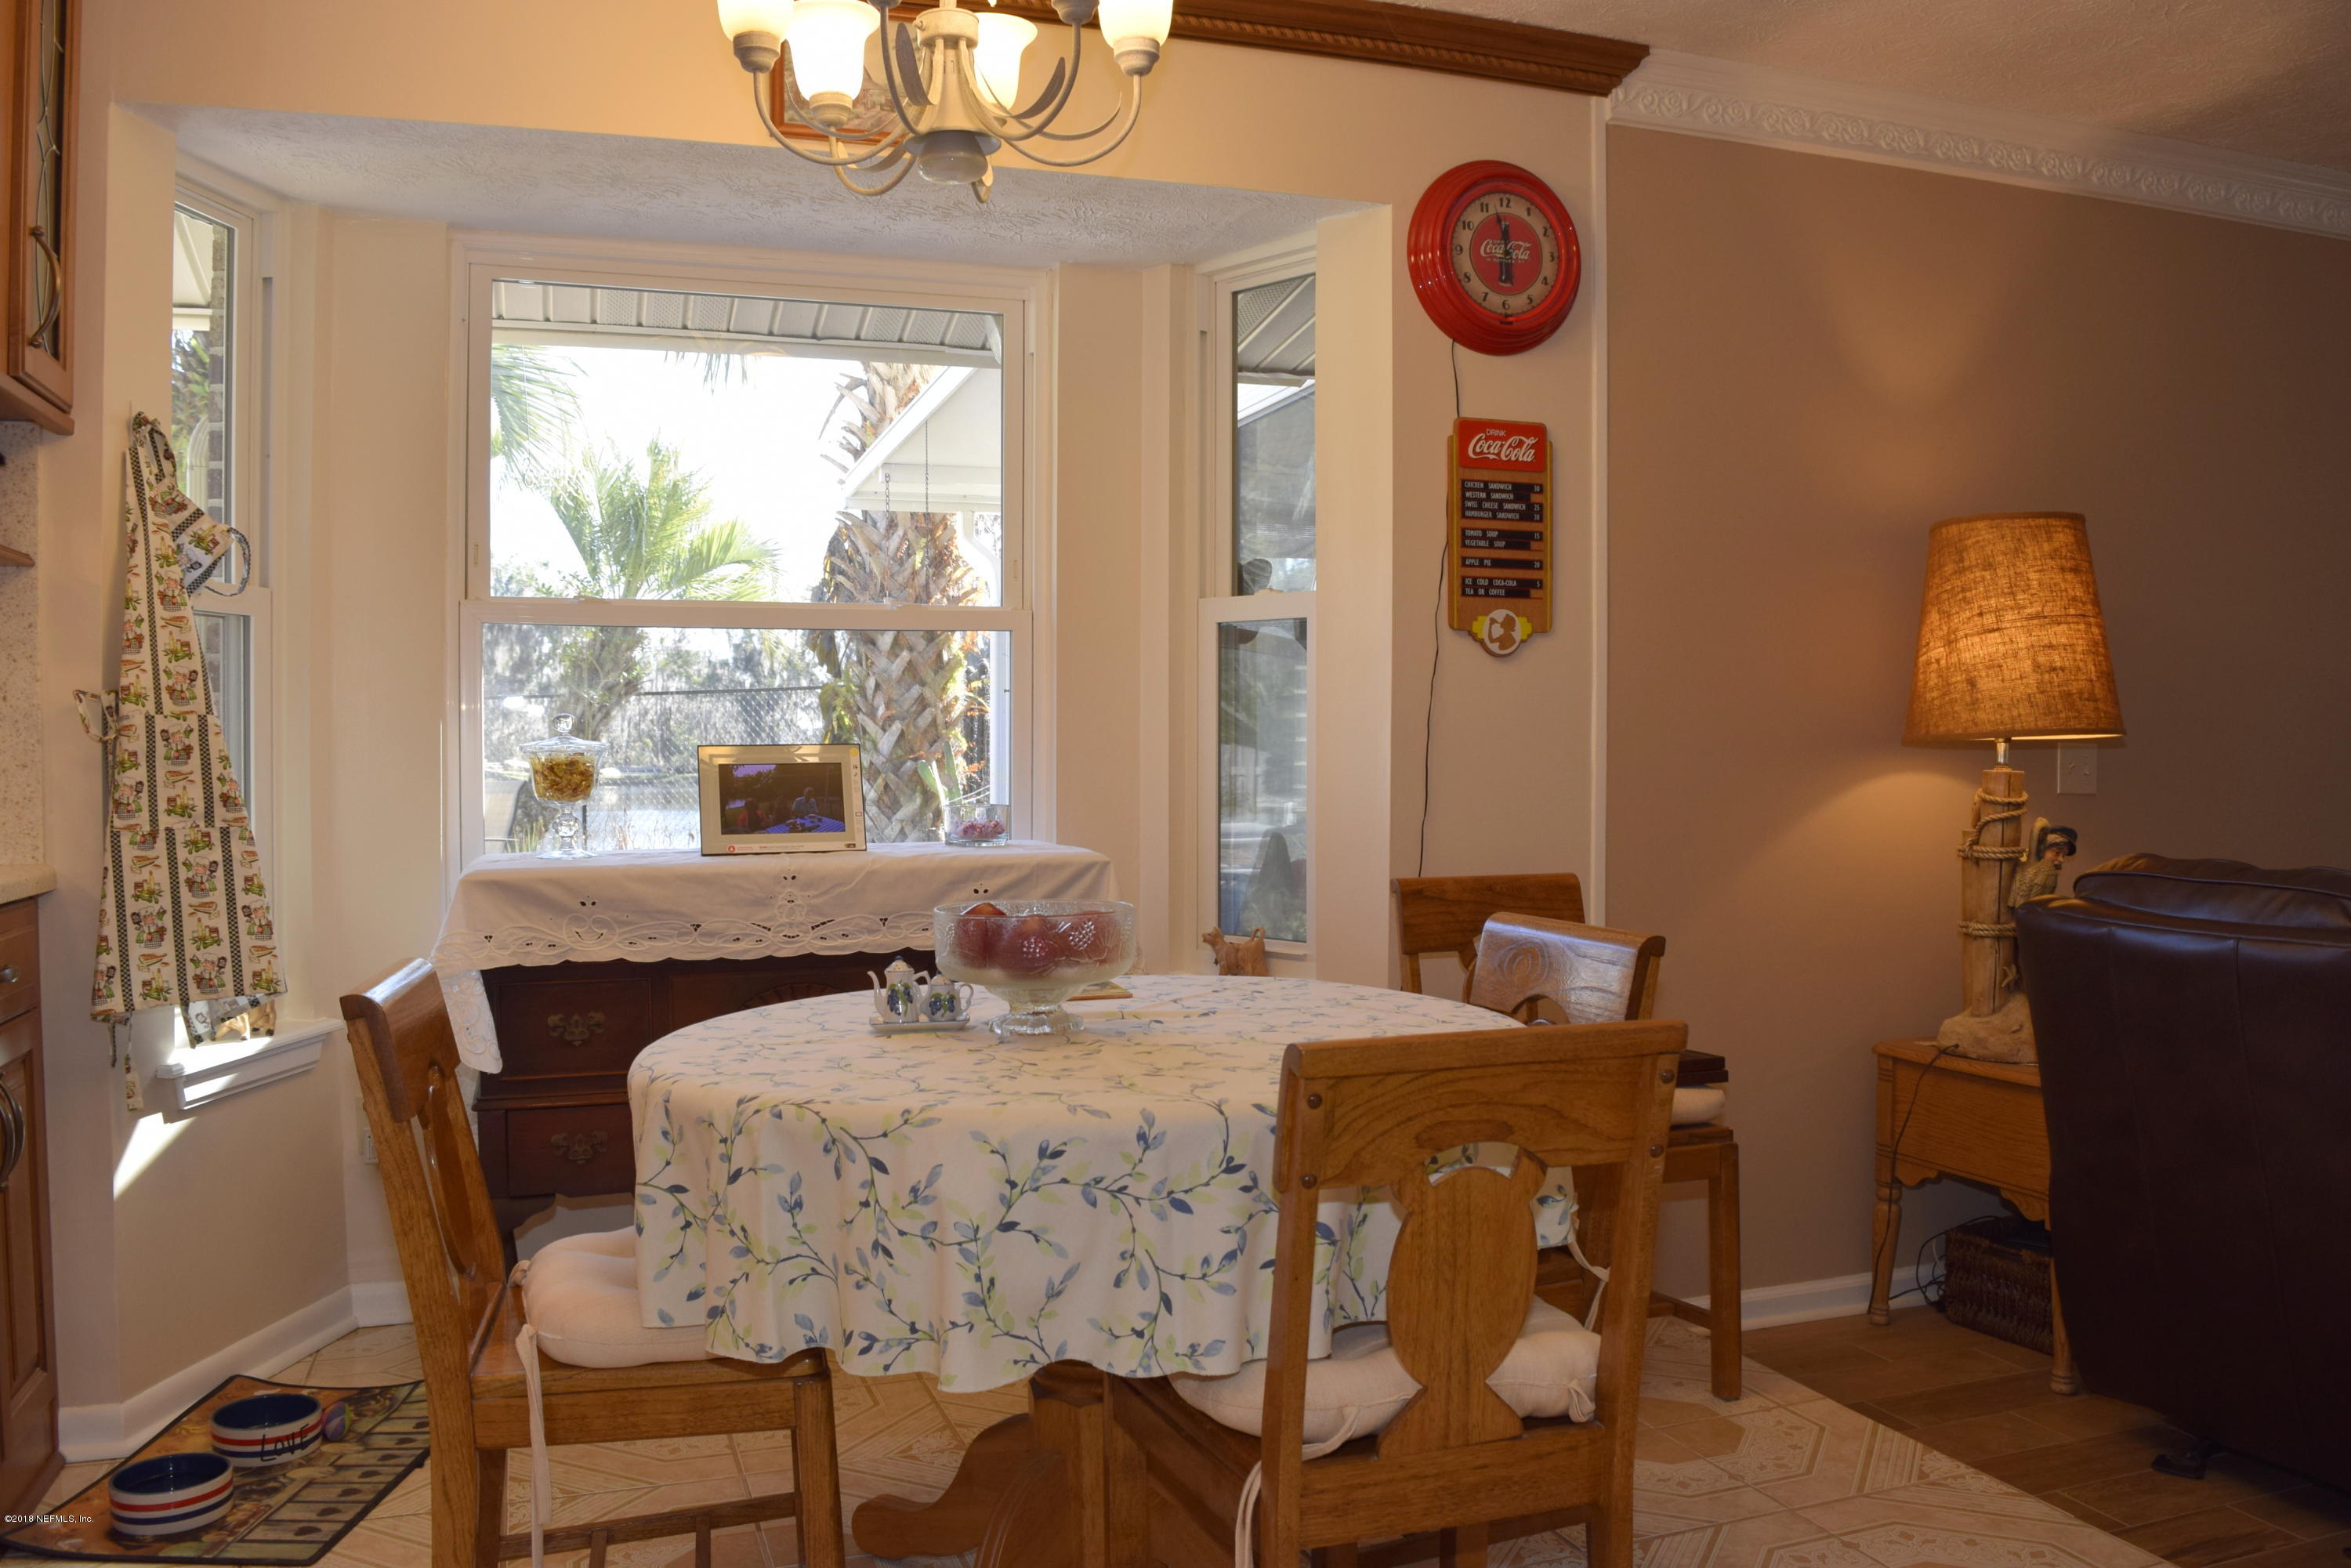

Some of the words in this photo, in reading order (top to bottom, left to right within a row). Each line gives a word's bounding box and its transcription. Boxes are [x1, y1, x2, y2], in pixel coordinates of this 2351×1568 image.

[1480, 202, 1489, 213] 11
[1499, 197, 1512, 208] 12
[1526, 207, 1531, 216] 1
[1462, 220, 1474, 230] 10
[1542, 226, 1549, 237] 2
[1454, 244, 1463, 255] 9
[1549, 252, 1555, 263] 3
[1463, 272, 1471, 282] 8
[1541, 276, 1549, 286] 4
[1482, 292, 1488, 302] 7
[1527, 295, 1534, 304] 5
[1502, 299, 1510, 310] 6
[1468, 433, 1538, 462] Coca-Cola
[1465, 480, 1484, 489] CHICKEN
[261, 1423, 309, 1461] LOVE
